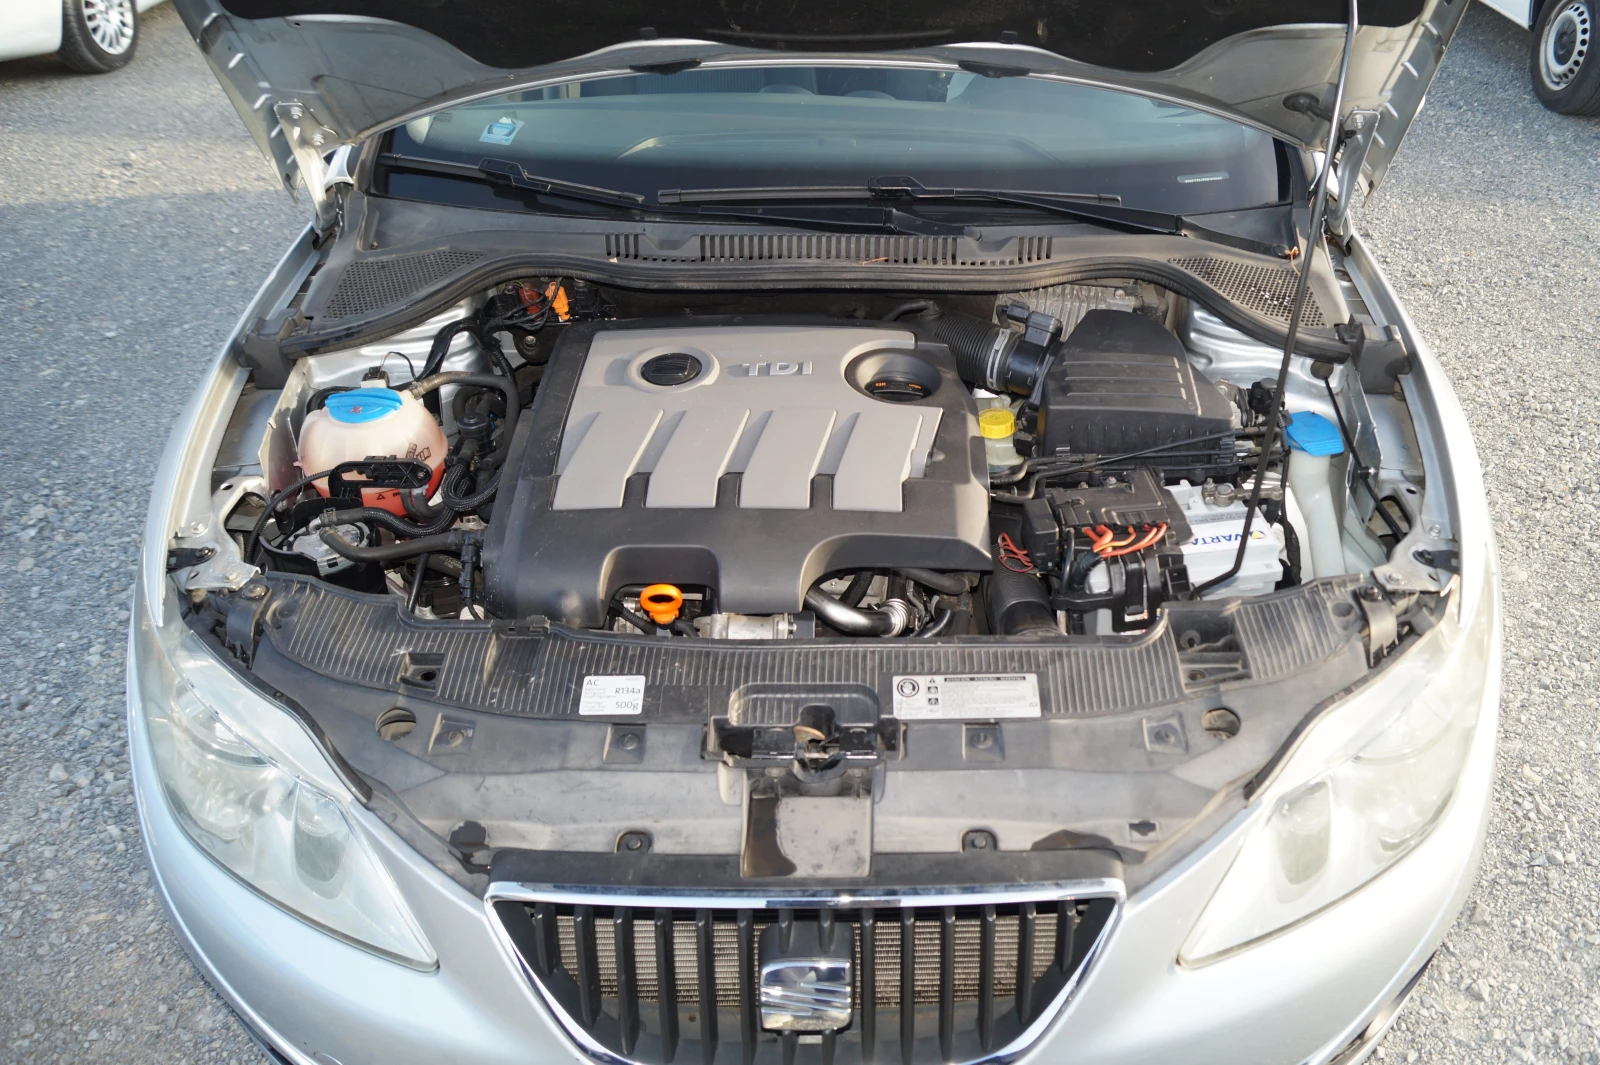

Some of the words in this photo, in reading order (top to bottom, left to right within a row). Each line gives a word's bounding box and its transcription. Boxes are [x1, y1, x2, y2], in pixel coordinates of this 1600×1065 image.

[741, 360, 812, 377] TDI
[1191, 533, 1243, 546] VARTA
[586, 679, 600, 687] AC
[615, 687, 641, 695] R134a
[615, 701, 639, 711] 500g
